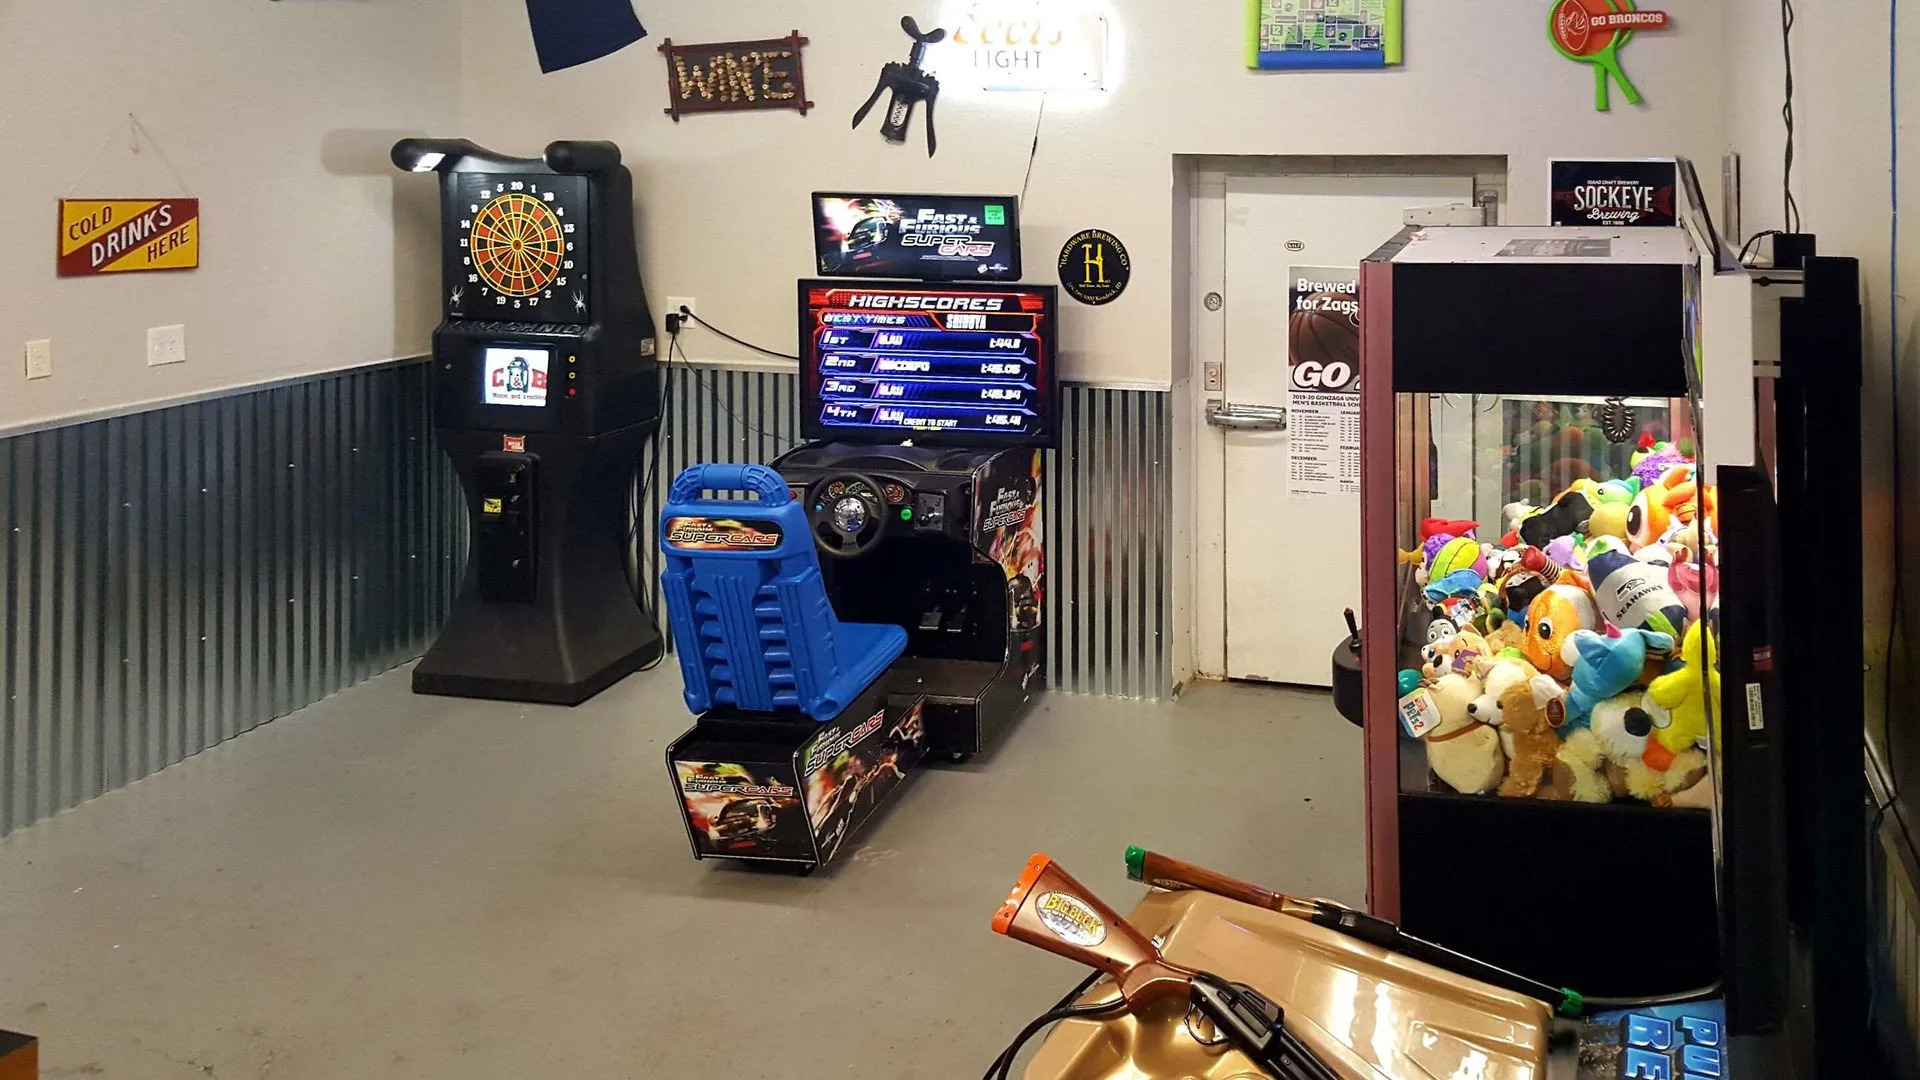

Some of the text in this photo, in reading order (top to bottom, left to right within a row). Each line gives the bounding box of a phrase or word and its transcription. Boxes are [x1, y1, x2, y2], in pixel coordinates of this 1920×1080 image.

[1591, 13, 1663, 27] GO BRONCOS
[974, 50, 1043, 68] LIGHT
[673, 51, 796, 102] WINE
[497, 184, 504, 192] 5
[511, 181, 523, 190] 20
[531, 184, 536, 193] 1
[480, 190, 491, 199] 12
[543, 192, 554, 201] 18
[1574, 186, 1654, 212] SOCKEYE
[471, 204, 478, 213] 9
[556, 207, 564, 216] 4
[918, 208, 967, 225] FAST
[1587, 208, 1640, 222] Brewing
[69, 206, 112, 240] COLD
[460, 220, 470, 228] 14
[564, 224, 575, 233] 13
[899, 219, 981, 234] FURIOUS
[91, 204, 172, 267] DRINKS
[901, 234, 972, 246] SUPER
[147, 225, 190, 262] HERE
[460, 238, 468, 247] 11
[566, 242, 573, 250] 6
[938, 242, 994, 257] CARS
[1061, 232, 1128, 266] HARDWARE BREWING CO
[463, 257, 470, 265] 8
[564, 261, 573, 269] 10
[468, 274, 478, 283] 16
[556, 277, 566, 286] 15
[482, 287, 488, 296] 7
[1296, 278, 1356, 294] Brewed
[545, 290, 552, 298] 2
[496, 296, 506, 305] 19
[514, 299, 521, 308] 3
[529, 297, 539, 306] 17
[849, 295, 1003, 310] HIGHSCORES
[1296, 296, 1318, 310] for
[823, 331, 849, 344] 1ST
[825, 356, 856, 367] 2ND
[1293, 361, 1351, 389] GO
[825, 381, 856, 392] 3RD
[827, 406, 857, 418] 4TH
[671, 532, 778, 546] SUPERCARS
[1616, 585, 1663, 621] SEAHAWKS
[805, 709, 885, 777] SUPERCARS
[685, 783, 793, 796] SUPERCARS
[1046, 893, 1071, 914] BIG
[1070, 905, 1103, 936] BUCK
[1681, 1016, 1720, 1080] PU
